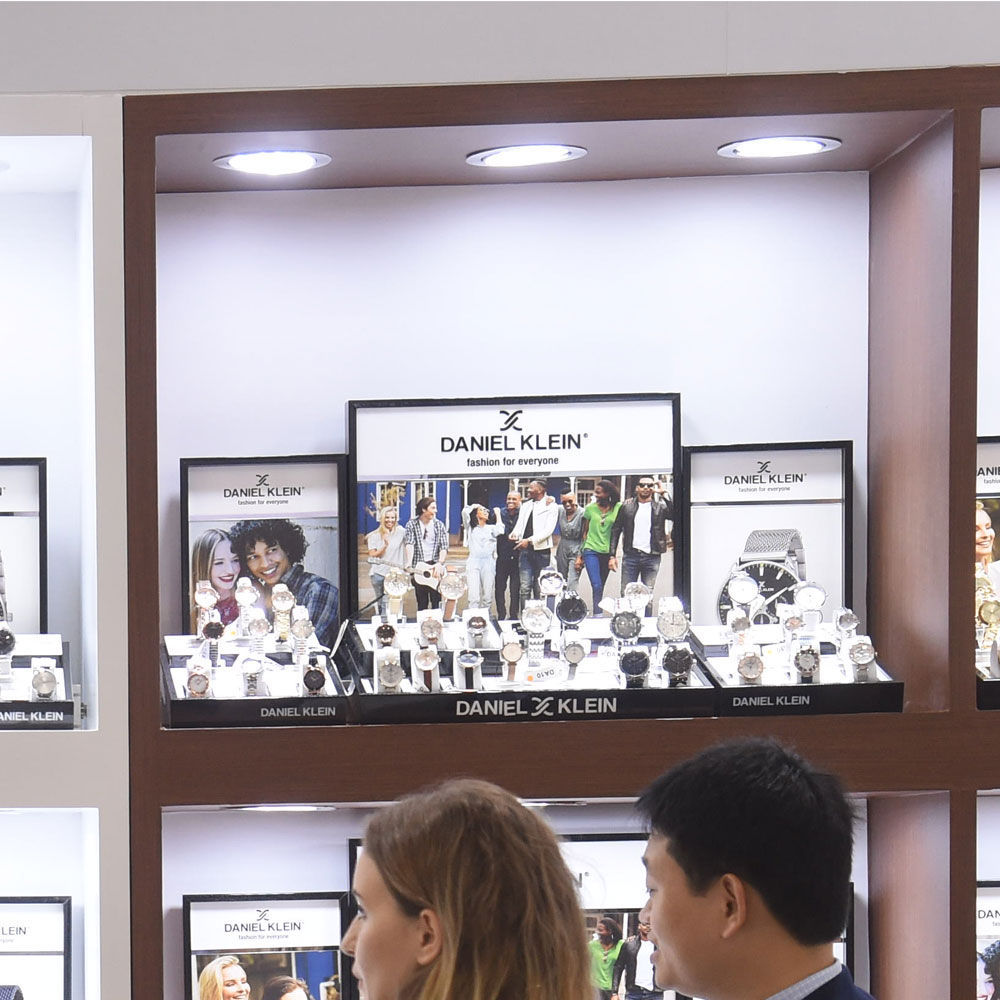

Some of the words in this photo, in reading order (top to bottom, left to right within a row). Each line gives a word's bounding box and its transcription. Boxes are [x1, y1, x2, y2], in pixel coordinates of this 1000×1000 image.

[440, 435, 516, 453] DANIEL
[520, 433, 581, 451] KLEIN
[466, 456, 501, 468] fashion
[502, 456, 516, 467] for
[517, 456, 559, 468] everyone
[724, 475, 767, 485] DANIEL
[769, 473, 804, 484] KLEIN
[223, 487, 265, 498] DANIEL
[267, 486, 302, 497] KLEIN
[455, 699, 528, 717] DANIEL
[557, 697, 618, 714] KLEIN
[732, 696, 774, 707] DANIEL
[776, 695, 810, 706] KLEIN
[30, 712, 64, 722] KLEIN
[260, 707, 302, 718] DANIEL
[303, 706, 336, 717] KLEIN
[224, 923, 266, 933] DANIEL
[267, 922, 302, 932] KLEIN
